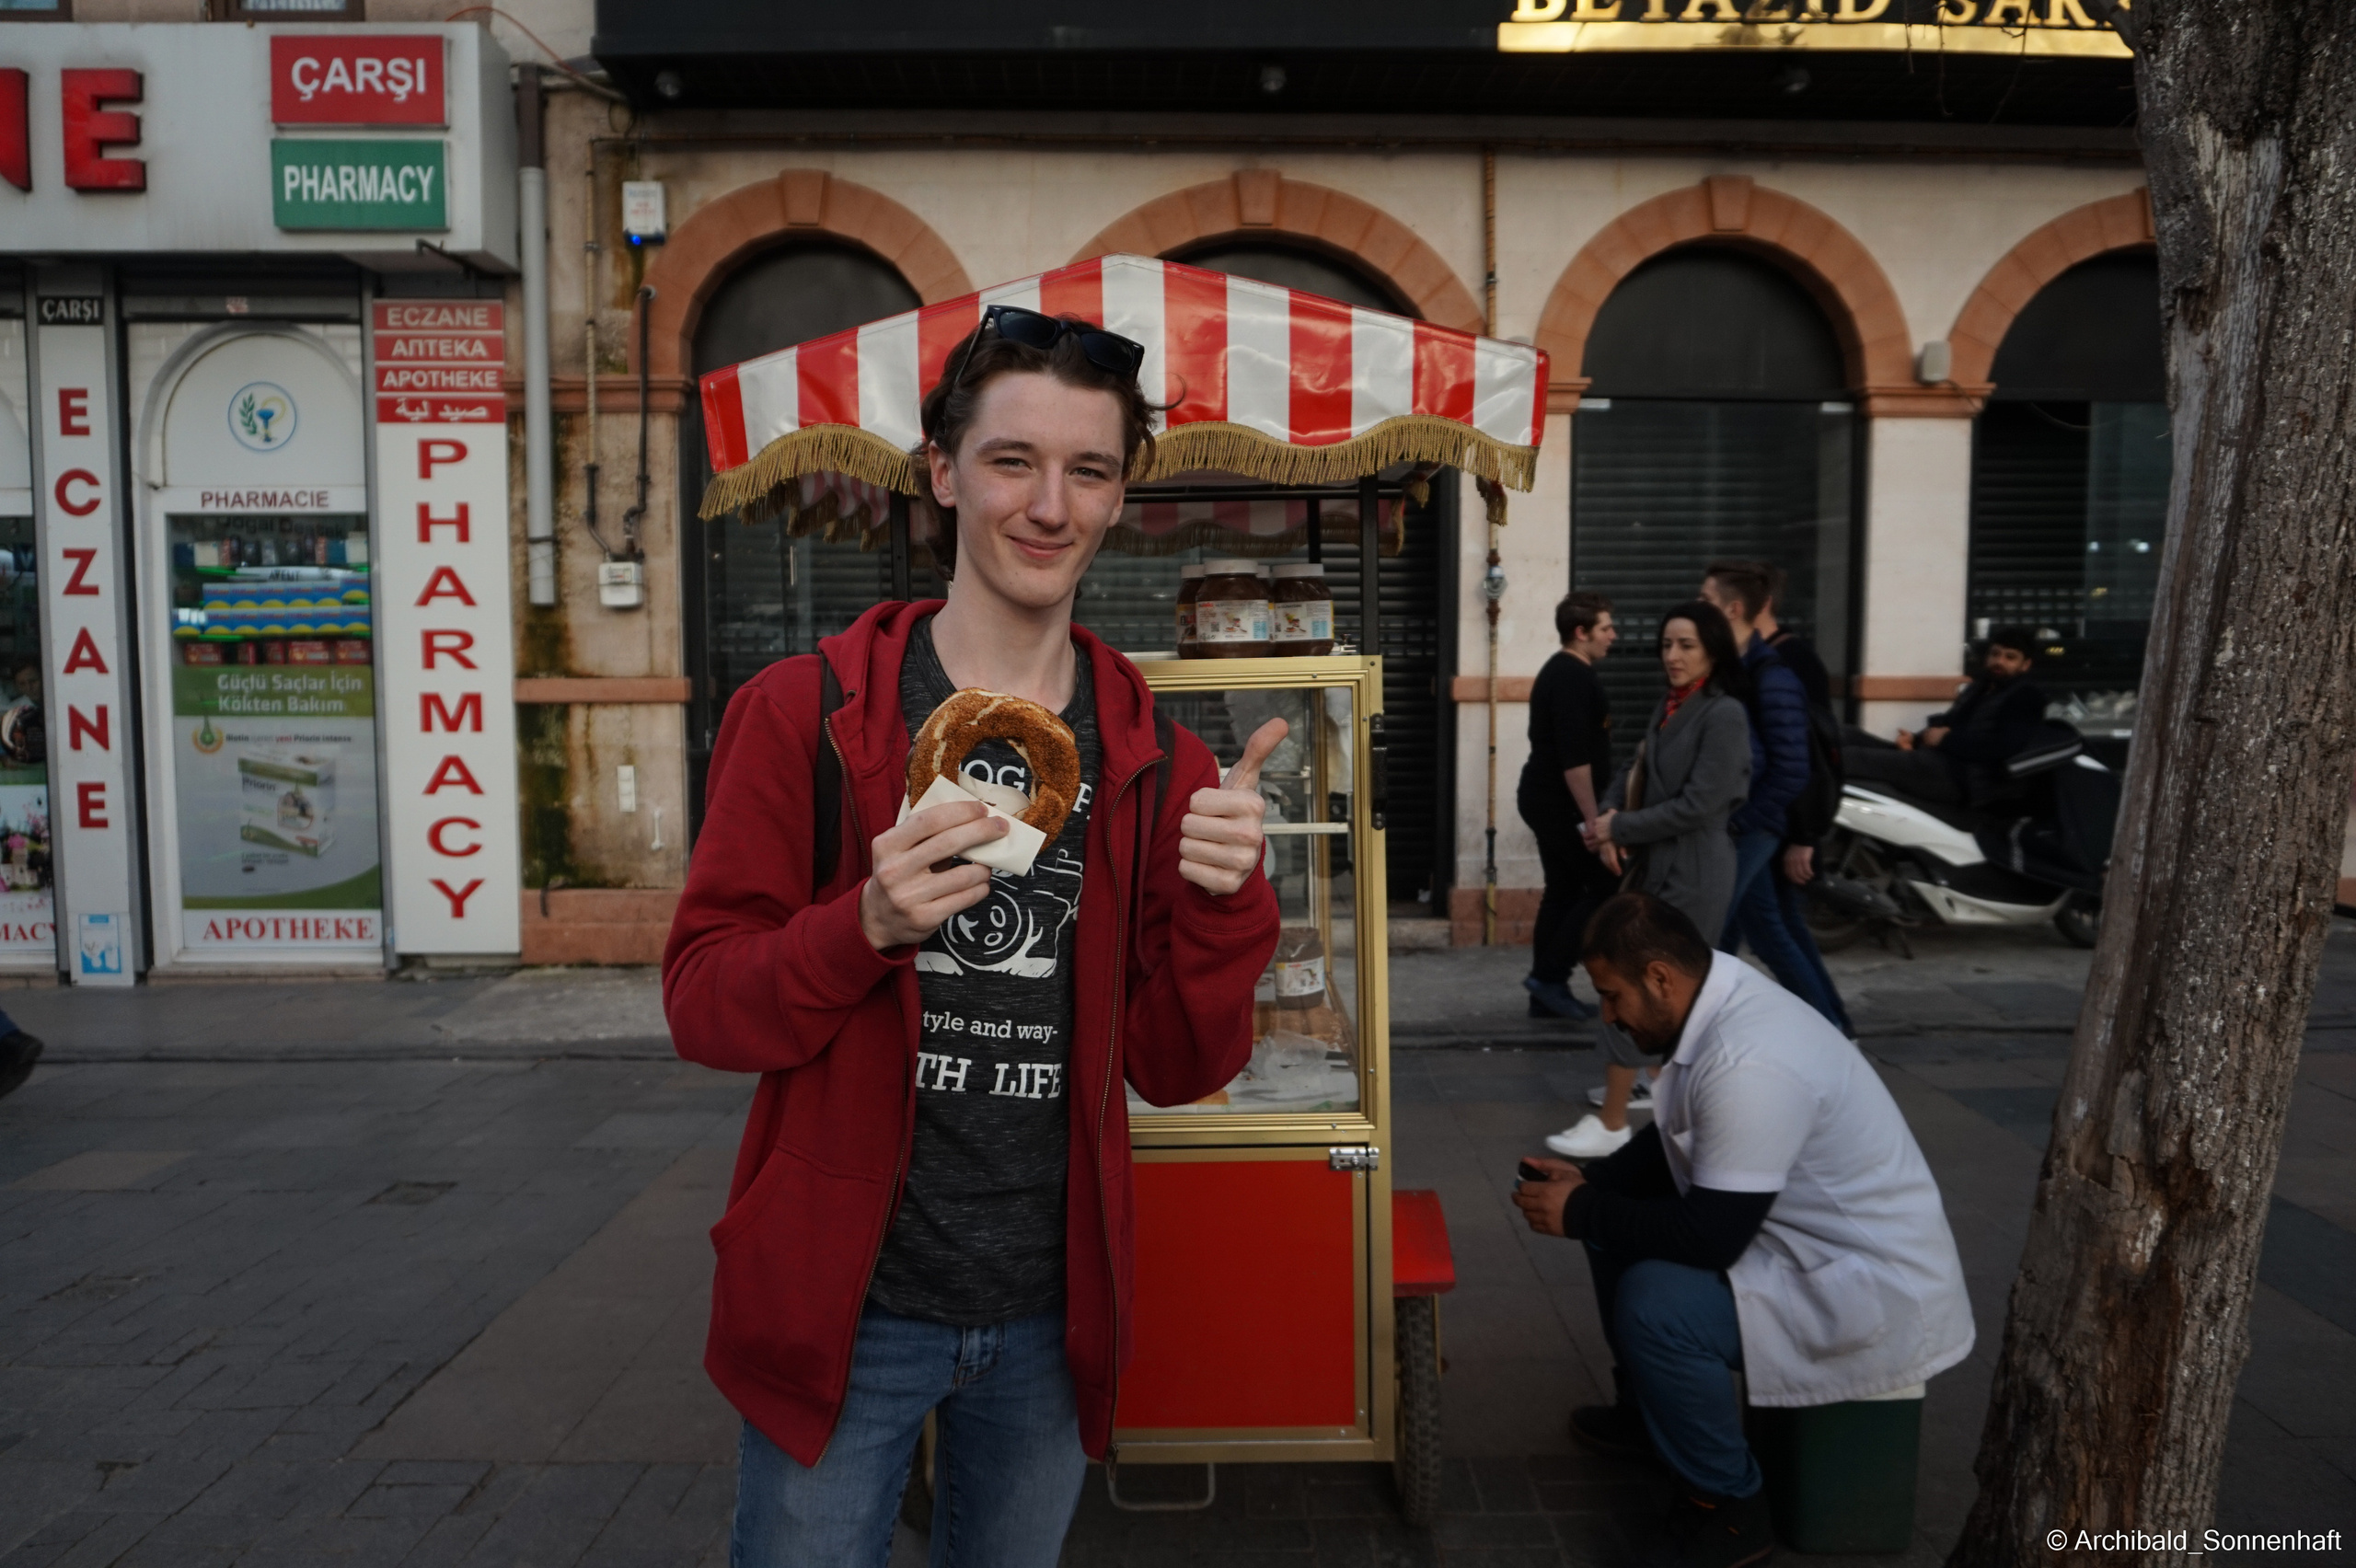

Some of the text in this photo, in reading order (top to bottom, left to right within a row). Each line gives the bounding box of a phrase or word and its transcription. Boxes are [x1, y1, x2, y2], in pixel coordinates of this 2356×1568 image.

[290, 56, 428, 103] ÇARŞI
[283, 164, 435, 202] PHARMACY
[41, 297, 100, 323] ÇARŞI
[387, 306, 490, 328] ECZANE
[391, 339, 489, 358] АПТЕКА
[383, 370, 499, 388] APOTHEKE
[201, 490, 330, 510] PHARMACIE
[55, 387, 110, 828] ECZANE
[217, 671, 362, 695] Güçlü Saçlar İçin
[414, 439, 485, 918] PHARMACY
[218, 695, 282, 712] Kökten
[202, 917, 374, 940] APOTHEKE
[970, 1020, 1011, 1039] and
